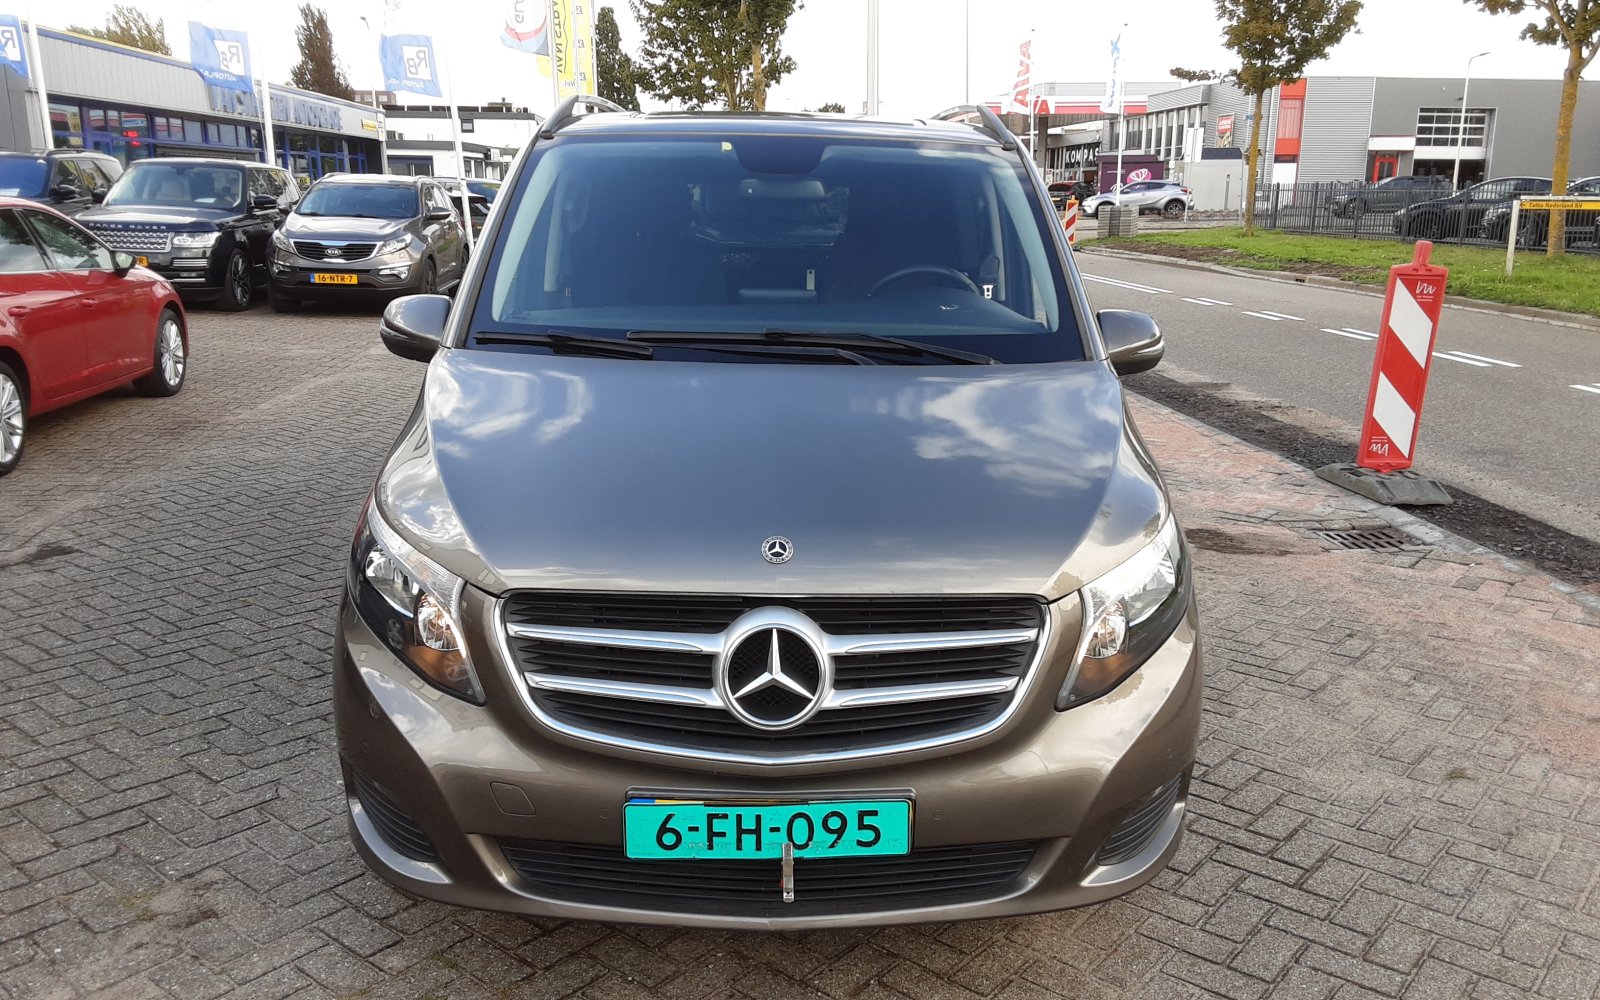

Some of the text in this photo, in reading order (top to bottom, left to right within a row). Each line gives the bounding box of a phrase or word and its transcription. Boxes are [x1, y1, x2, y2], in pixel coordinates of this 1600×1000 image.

[1065, 147, 1099, 164] KOMPAS
[317, 274, 353, 283] 16-NTR-7
[655, 809, 882, 852] 6-FH-095
